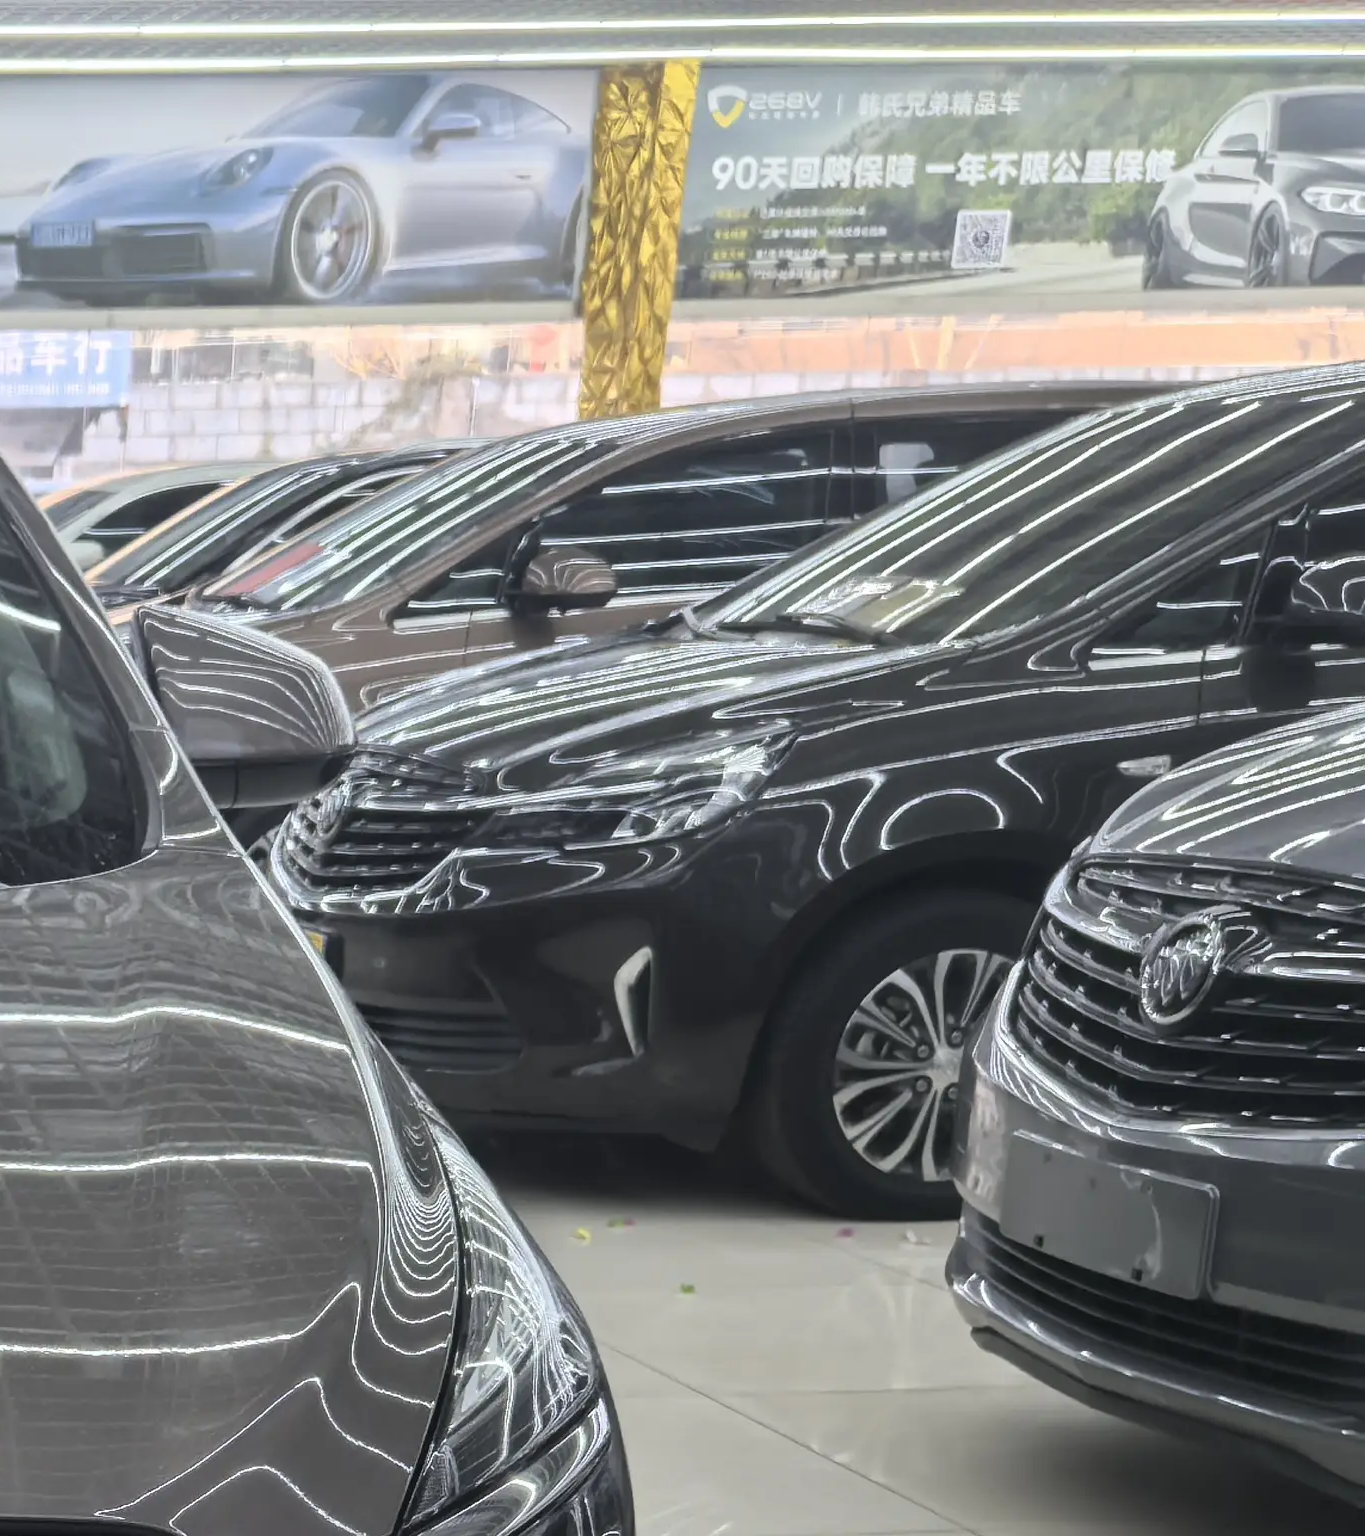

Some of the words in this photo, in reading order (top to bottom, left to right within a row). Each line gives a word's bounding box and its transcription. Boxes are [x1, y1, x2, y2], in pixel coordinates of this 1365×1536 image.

[748, 90, 823, 110] 268V
[859, 91, 1022, 117] 韩氏兄弟精品车
[711, 154, 917, 190] 90天回购保障
[925, 150, 1176, 186] 一年不限公里保修
